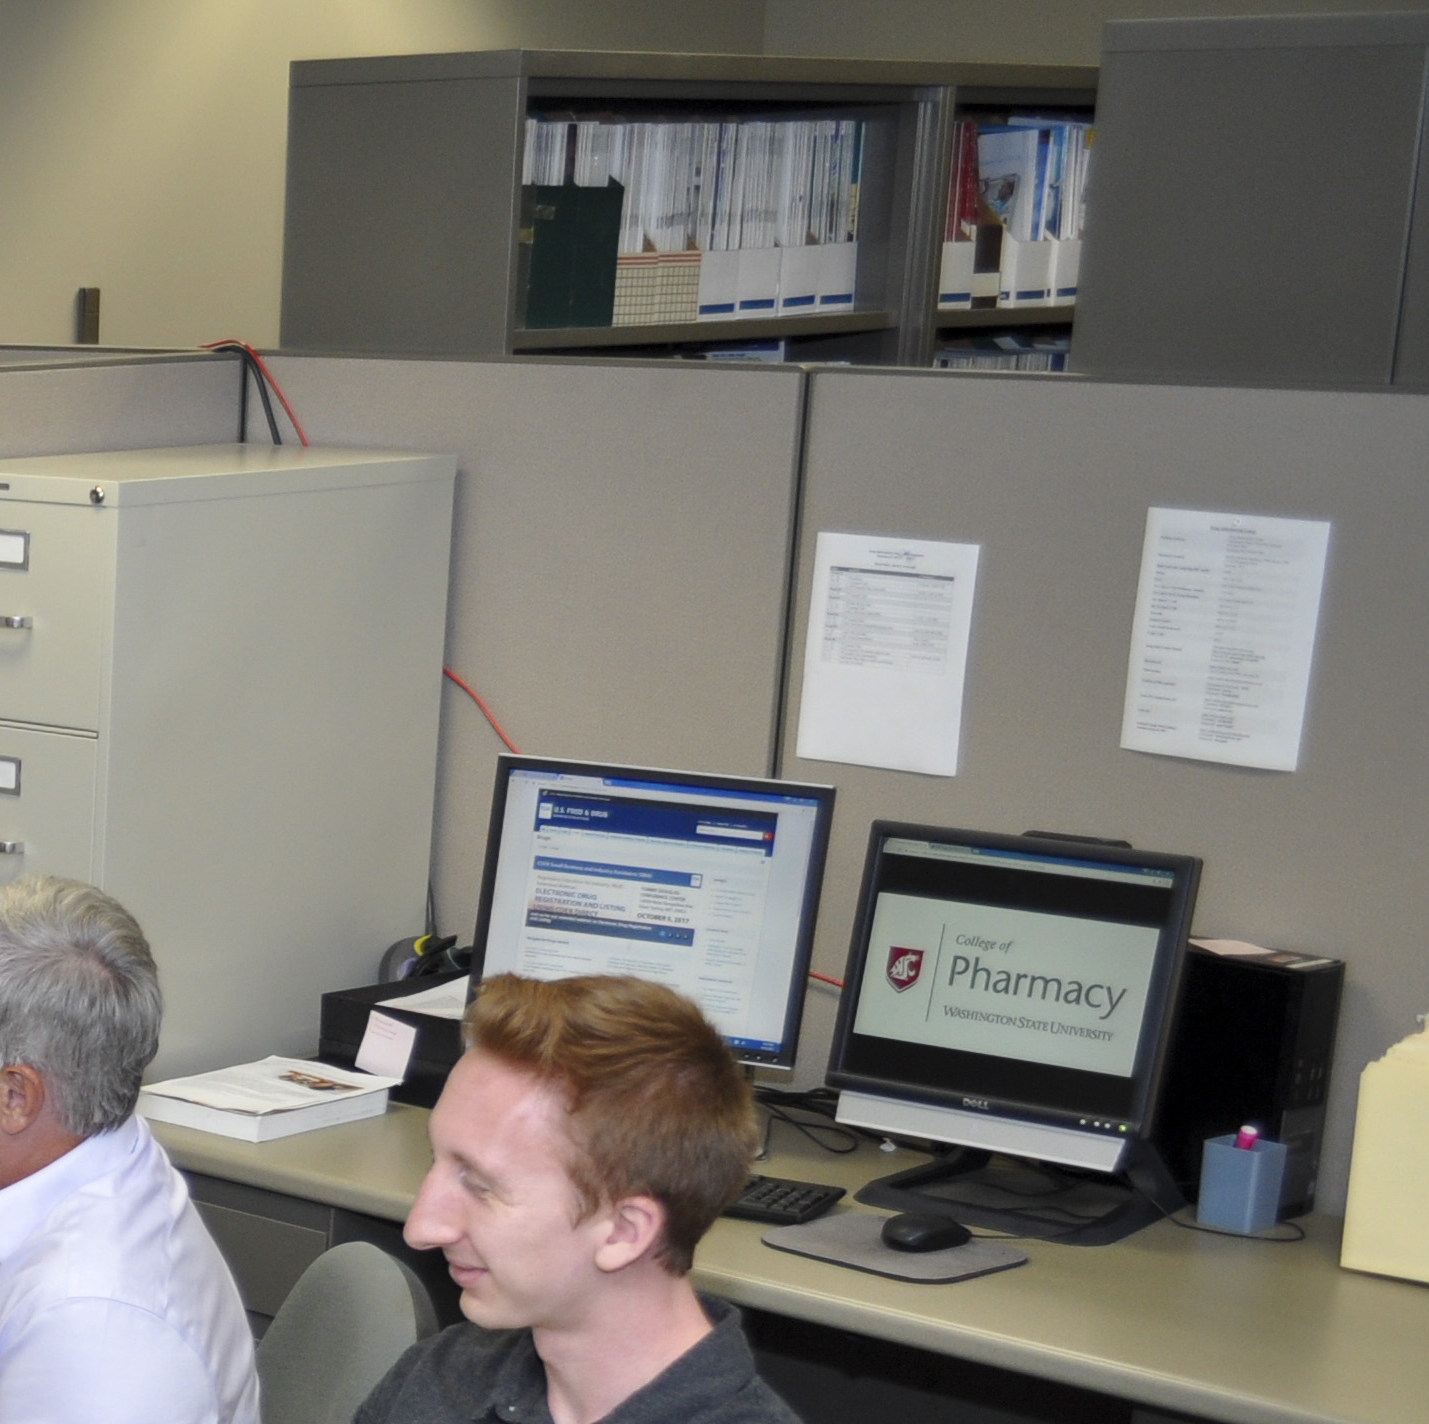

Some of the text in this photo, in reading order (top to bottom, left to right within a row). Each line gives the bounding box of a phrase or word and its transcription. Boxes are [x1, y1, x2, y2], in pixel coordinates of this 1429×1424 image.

[535, 888, 575, 899] ELECTRONIC
[534, 896, 626, 912] REGISTRATION AND LISTING
[637, 912, 666, 921] OCTOBER
[955, 934, 1013, 955] College of
[948, 955, 1127, 1020] Pharmacy
[943, 1005, 1114, 1042] WASHINGTON STATE UNIVERSITY
